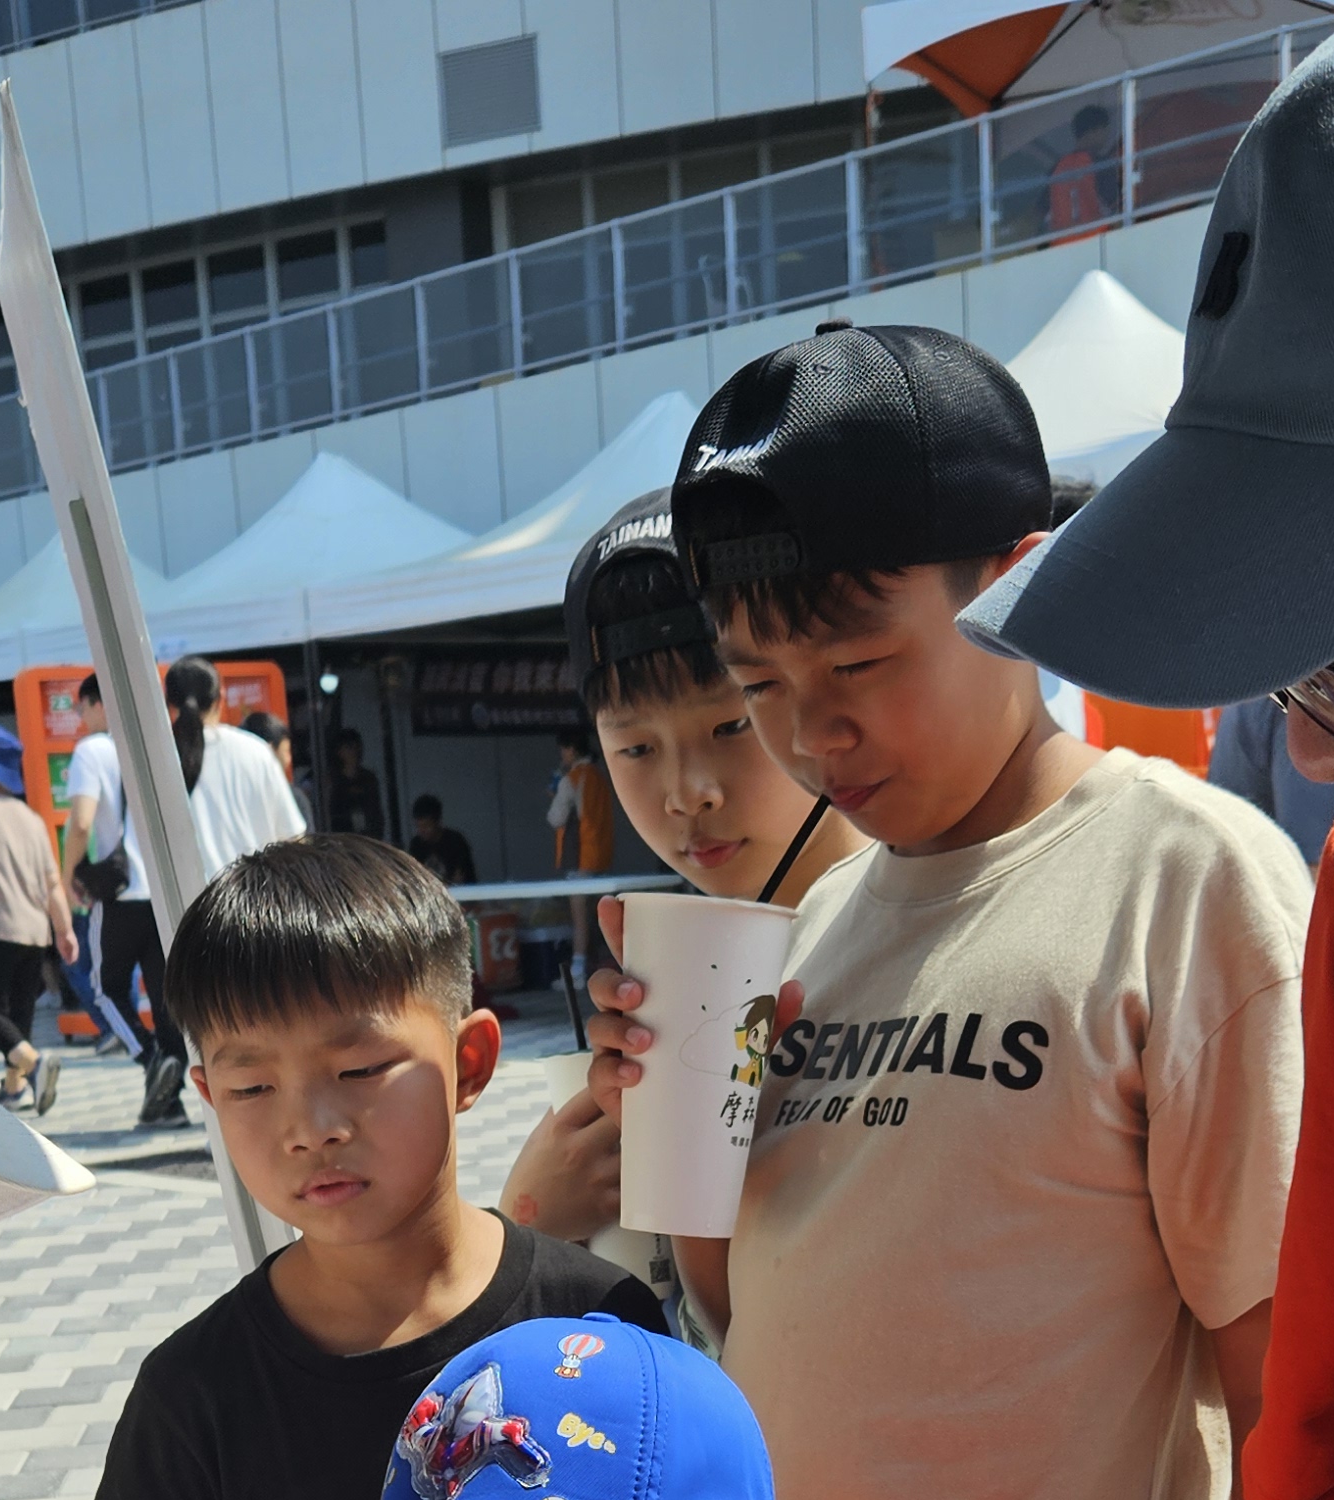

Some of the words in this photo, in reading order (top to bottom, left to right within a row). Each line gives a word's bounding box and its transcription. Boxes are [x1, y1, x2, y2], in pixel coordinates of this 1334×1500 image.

[769, 1013, 1049, 1091] SENTIALS
[822, 1096, 854, 1124] OF
[862, 1096, 910, 1127] GOD
